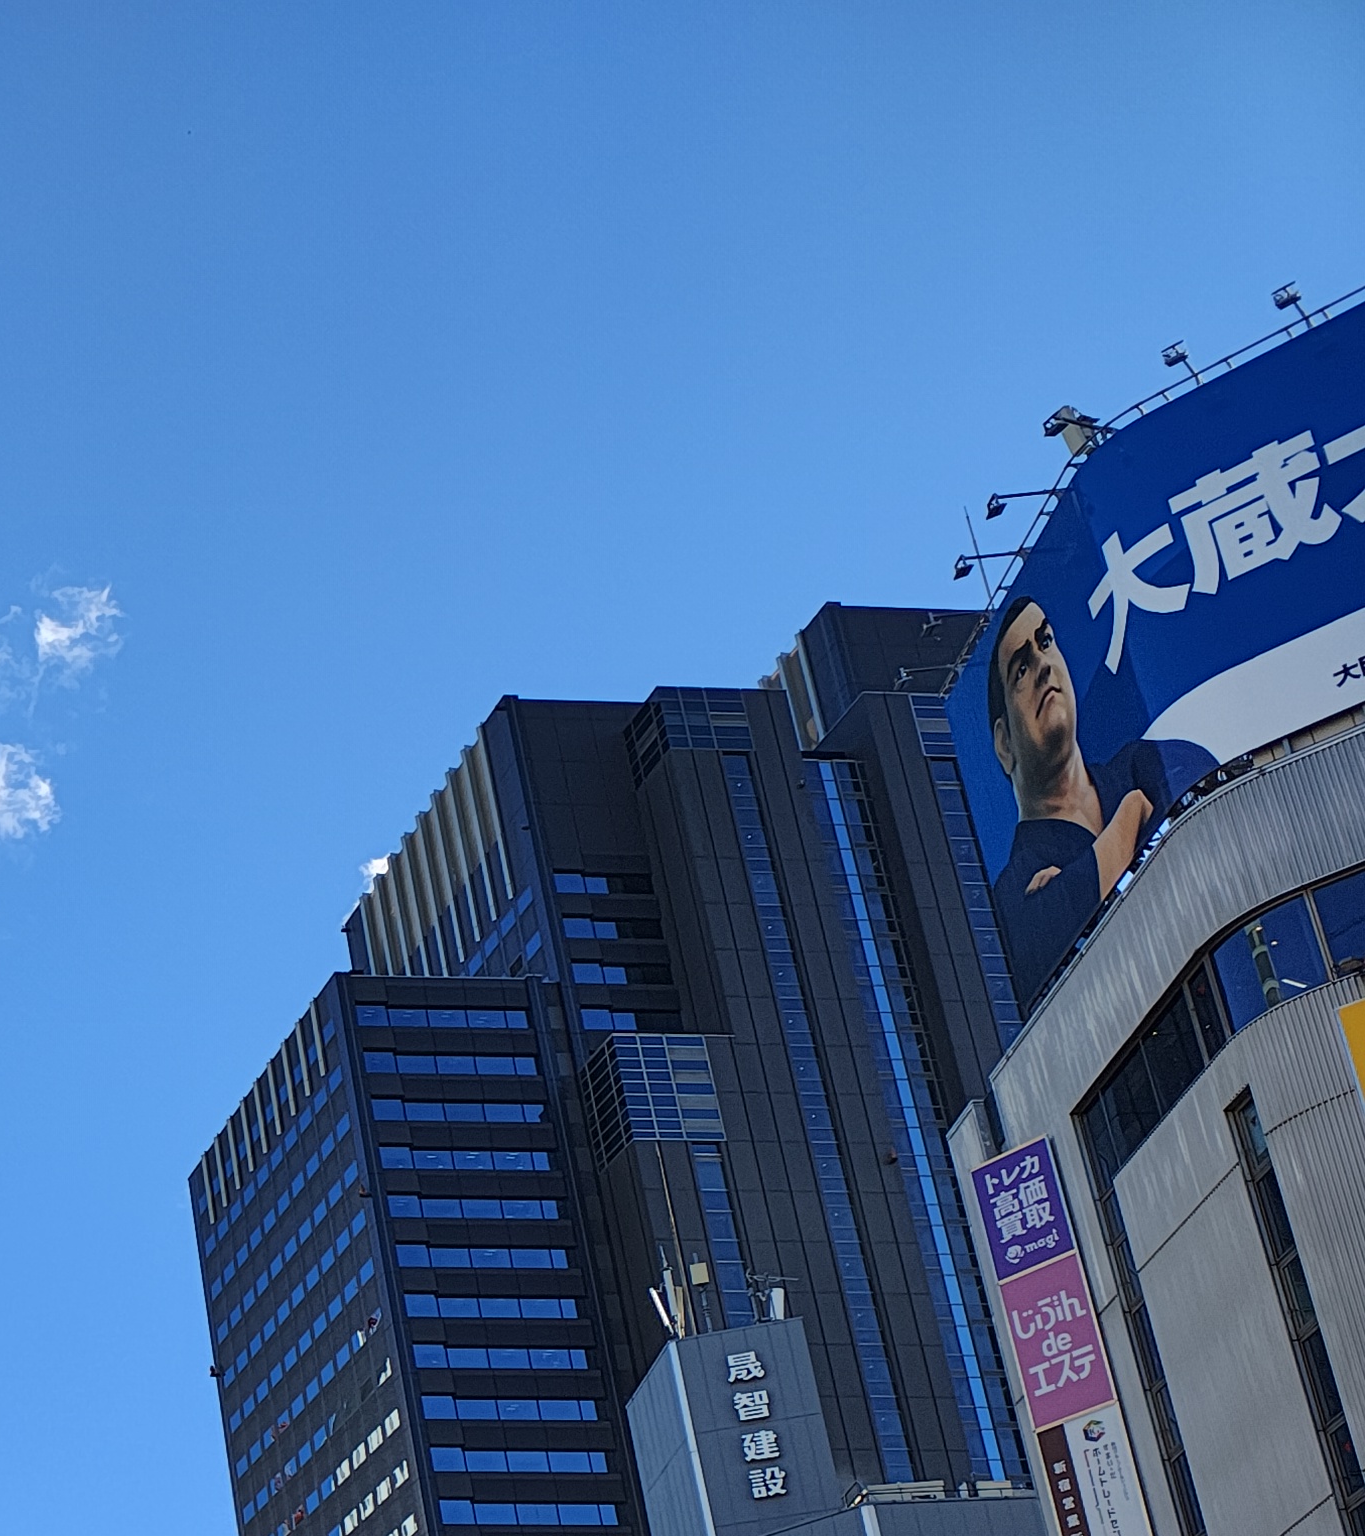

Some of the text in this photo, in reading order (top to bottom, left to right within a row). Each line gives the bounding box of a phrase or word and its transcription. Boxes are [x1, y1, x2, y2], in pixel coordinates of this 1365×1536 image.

[984, 1155, 1040, 1194] トレカ
[990, 1175, 1048, 1220] 高価
[996, 1201, 1055, 1243] 買取
[1024, 1229, 1060, 1253] magi
[1012, 1290, 1087, 1339] じぶん
[1042, 1331, 1072, 1357] de
[1029, 1344, 1096, 1397] エステ
[727, 1351, 787, 1499] 晟智建設
